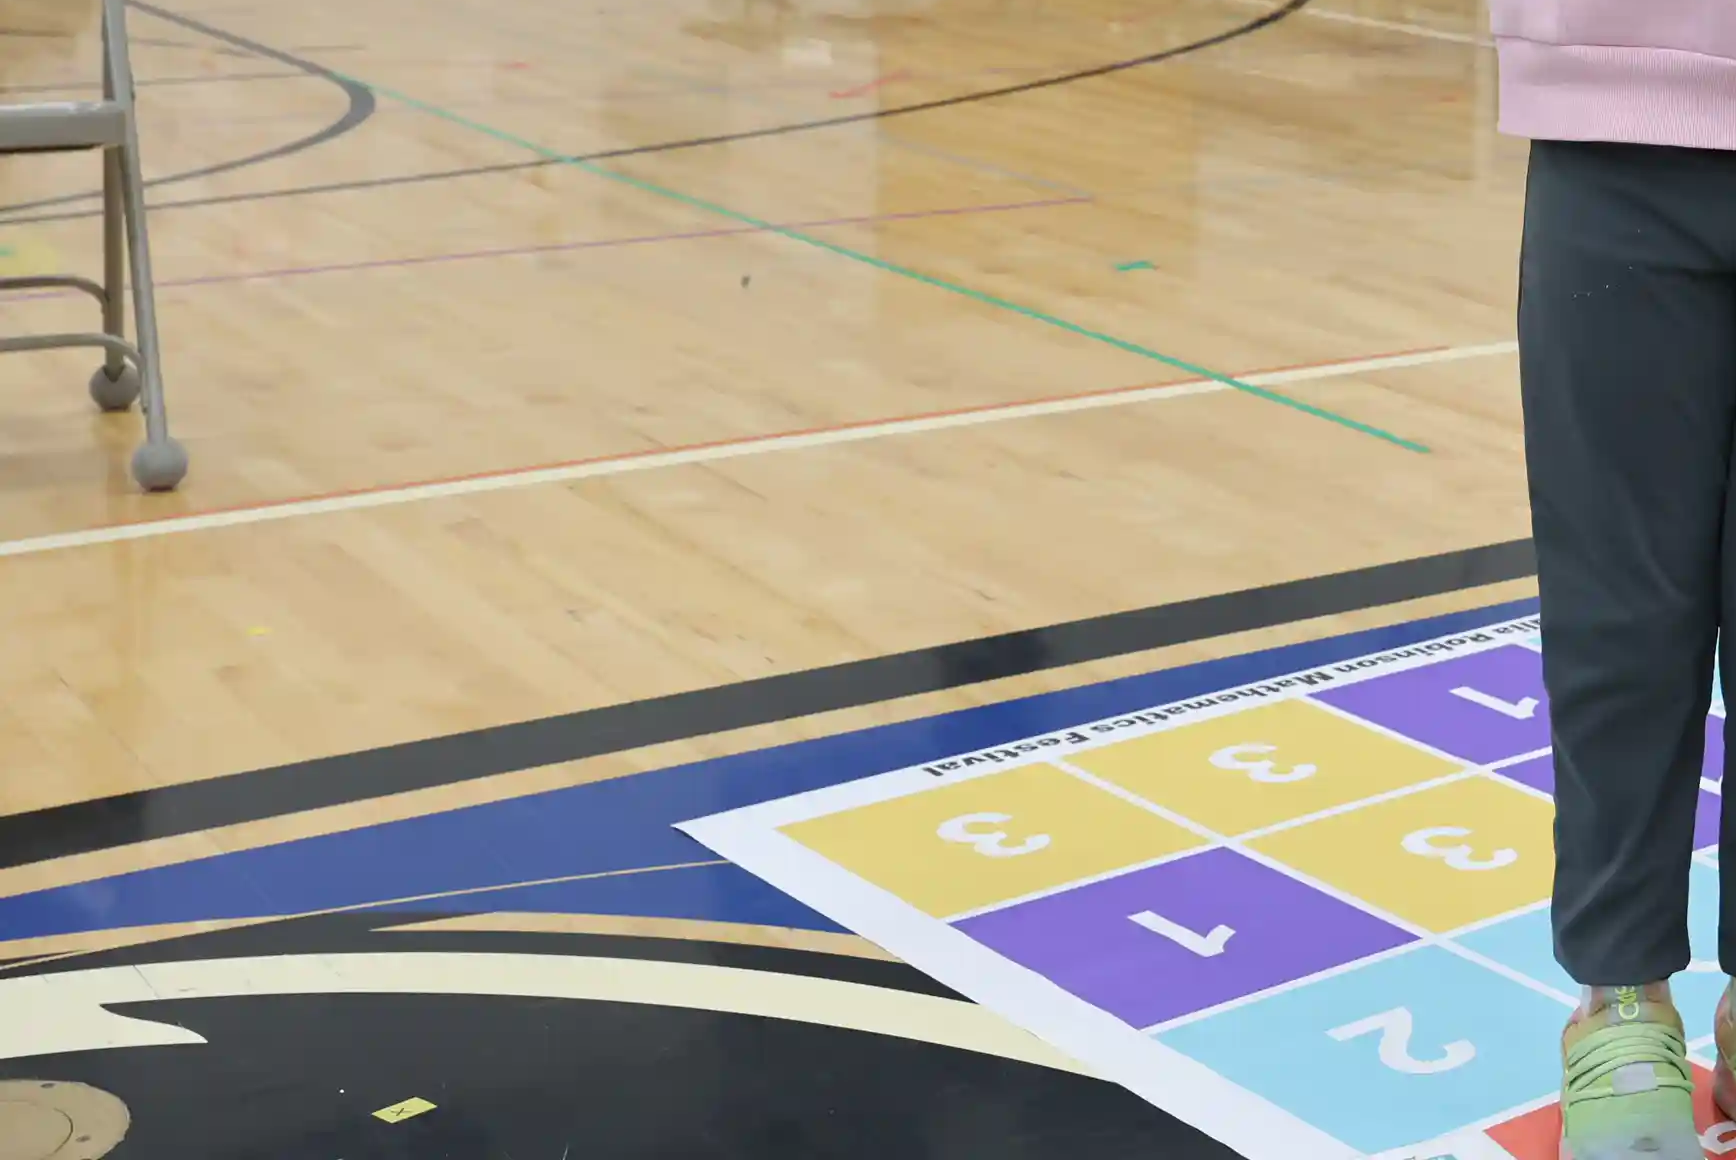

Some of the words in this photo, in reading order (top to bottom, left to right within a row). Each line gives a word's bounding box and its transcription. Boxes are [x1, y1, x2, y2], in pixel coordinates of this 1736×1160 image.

[1335, 632, 1495, 673] Robinson
[1090, 670, 1335, 733] Mathematics
[1449, 685, 1540, 720] 1
[922, 730, 1091, 777] Festival
[1208, 742, 1318, 784] 3
[936, 810, 1052, 858] 3
[1400, 825, 1520, 872] 3
[1126, 909, 1237, 958] 1
[1327, 1006, 1477, 1075] 2
